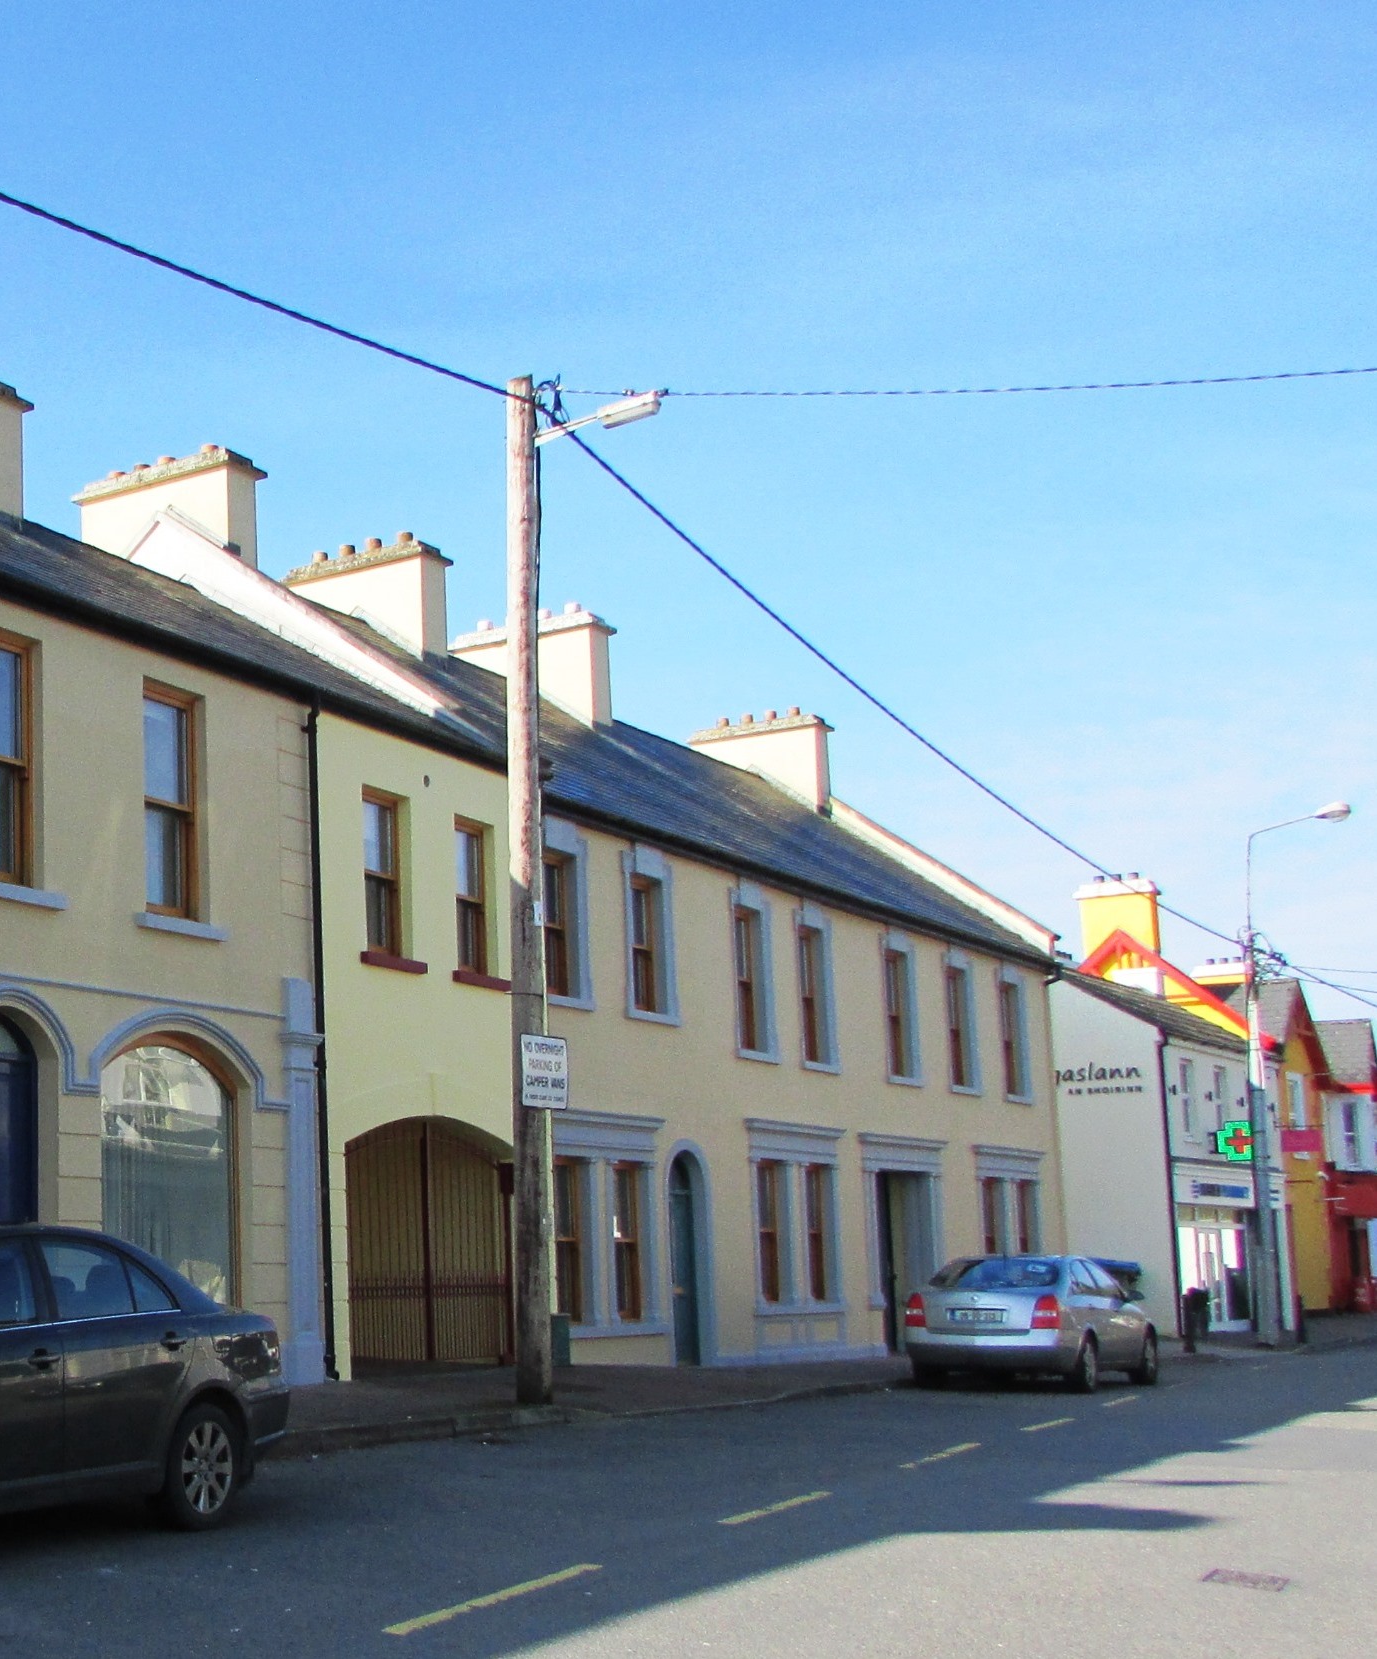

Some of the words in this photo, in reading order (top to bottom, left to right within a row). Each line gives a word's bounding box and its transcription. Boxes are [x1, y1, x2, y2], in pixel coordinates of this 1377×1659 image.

[524, 1041, 533, 1053] NO
[534, 1042, 565, 1056] OVERNIGHT
[528, 1058, 553, 1072] PARKING
[554, 1061, 561, 1072] OF
[526, 1075, 549, 1088] CAMPER
[551, 1078, 565, 1089] VANS
[1068, 1087, 1082, 1096] AN
